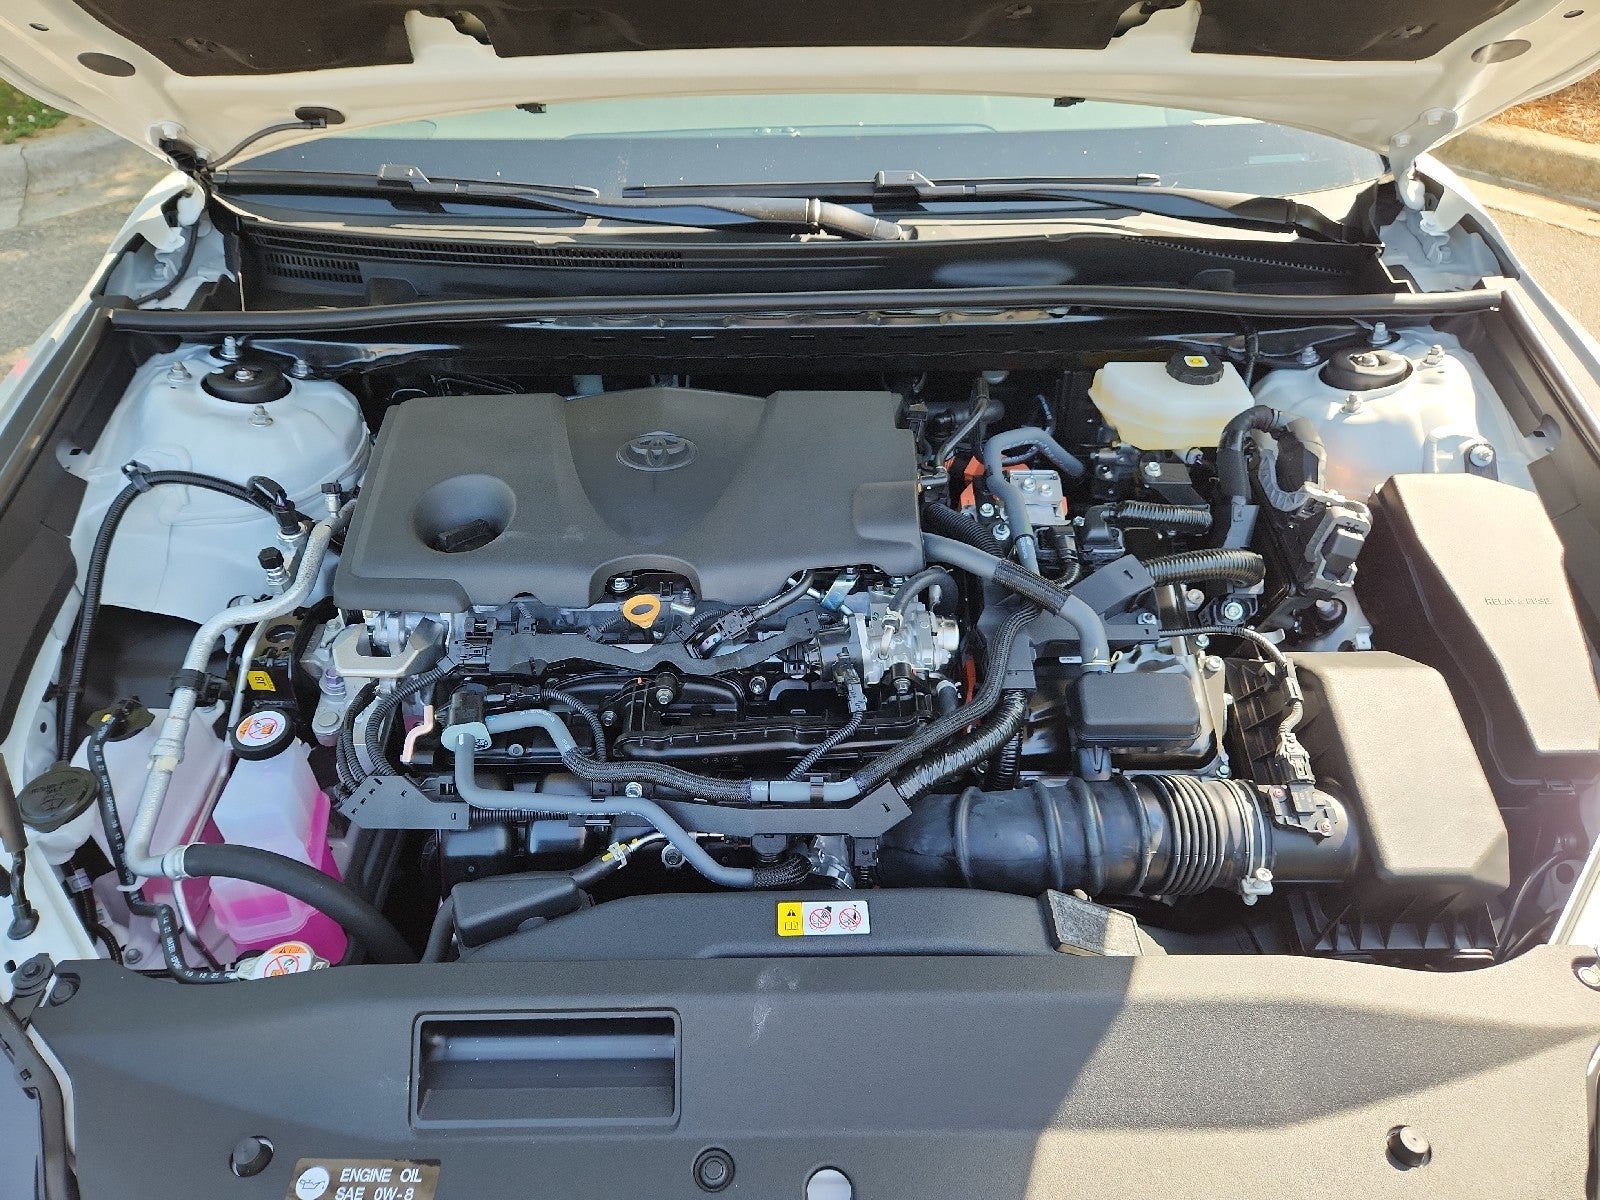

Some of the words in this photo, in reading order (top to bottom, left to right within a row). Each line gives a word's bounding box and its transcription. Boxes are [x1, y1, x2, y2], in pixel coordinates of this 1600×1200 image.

[1484, 597, 1516, 606] RELAY
[1525, 597, 1552, 605] FUSE
[339, 1168, 393, 1183] ENGINE
[399, 1168, 423, 1183] OIL
[334, 1186, 366, 1200] SAE
[374, 1186, 415, 1200] 0W-8
